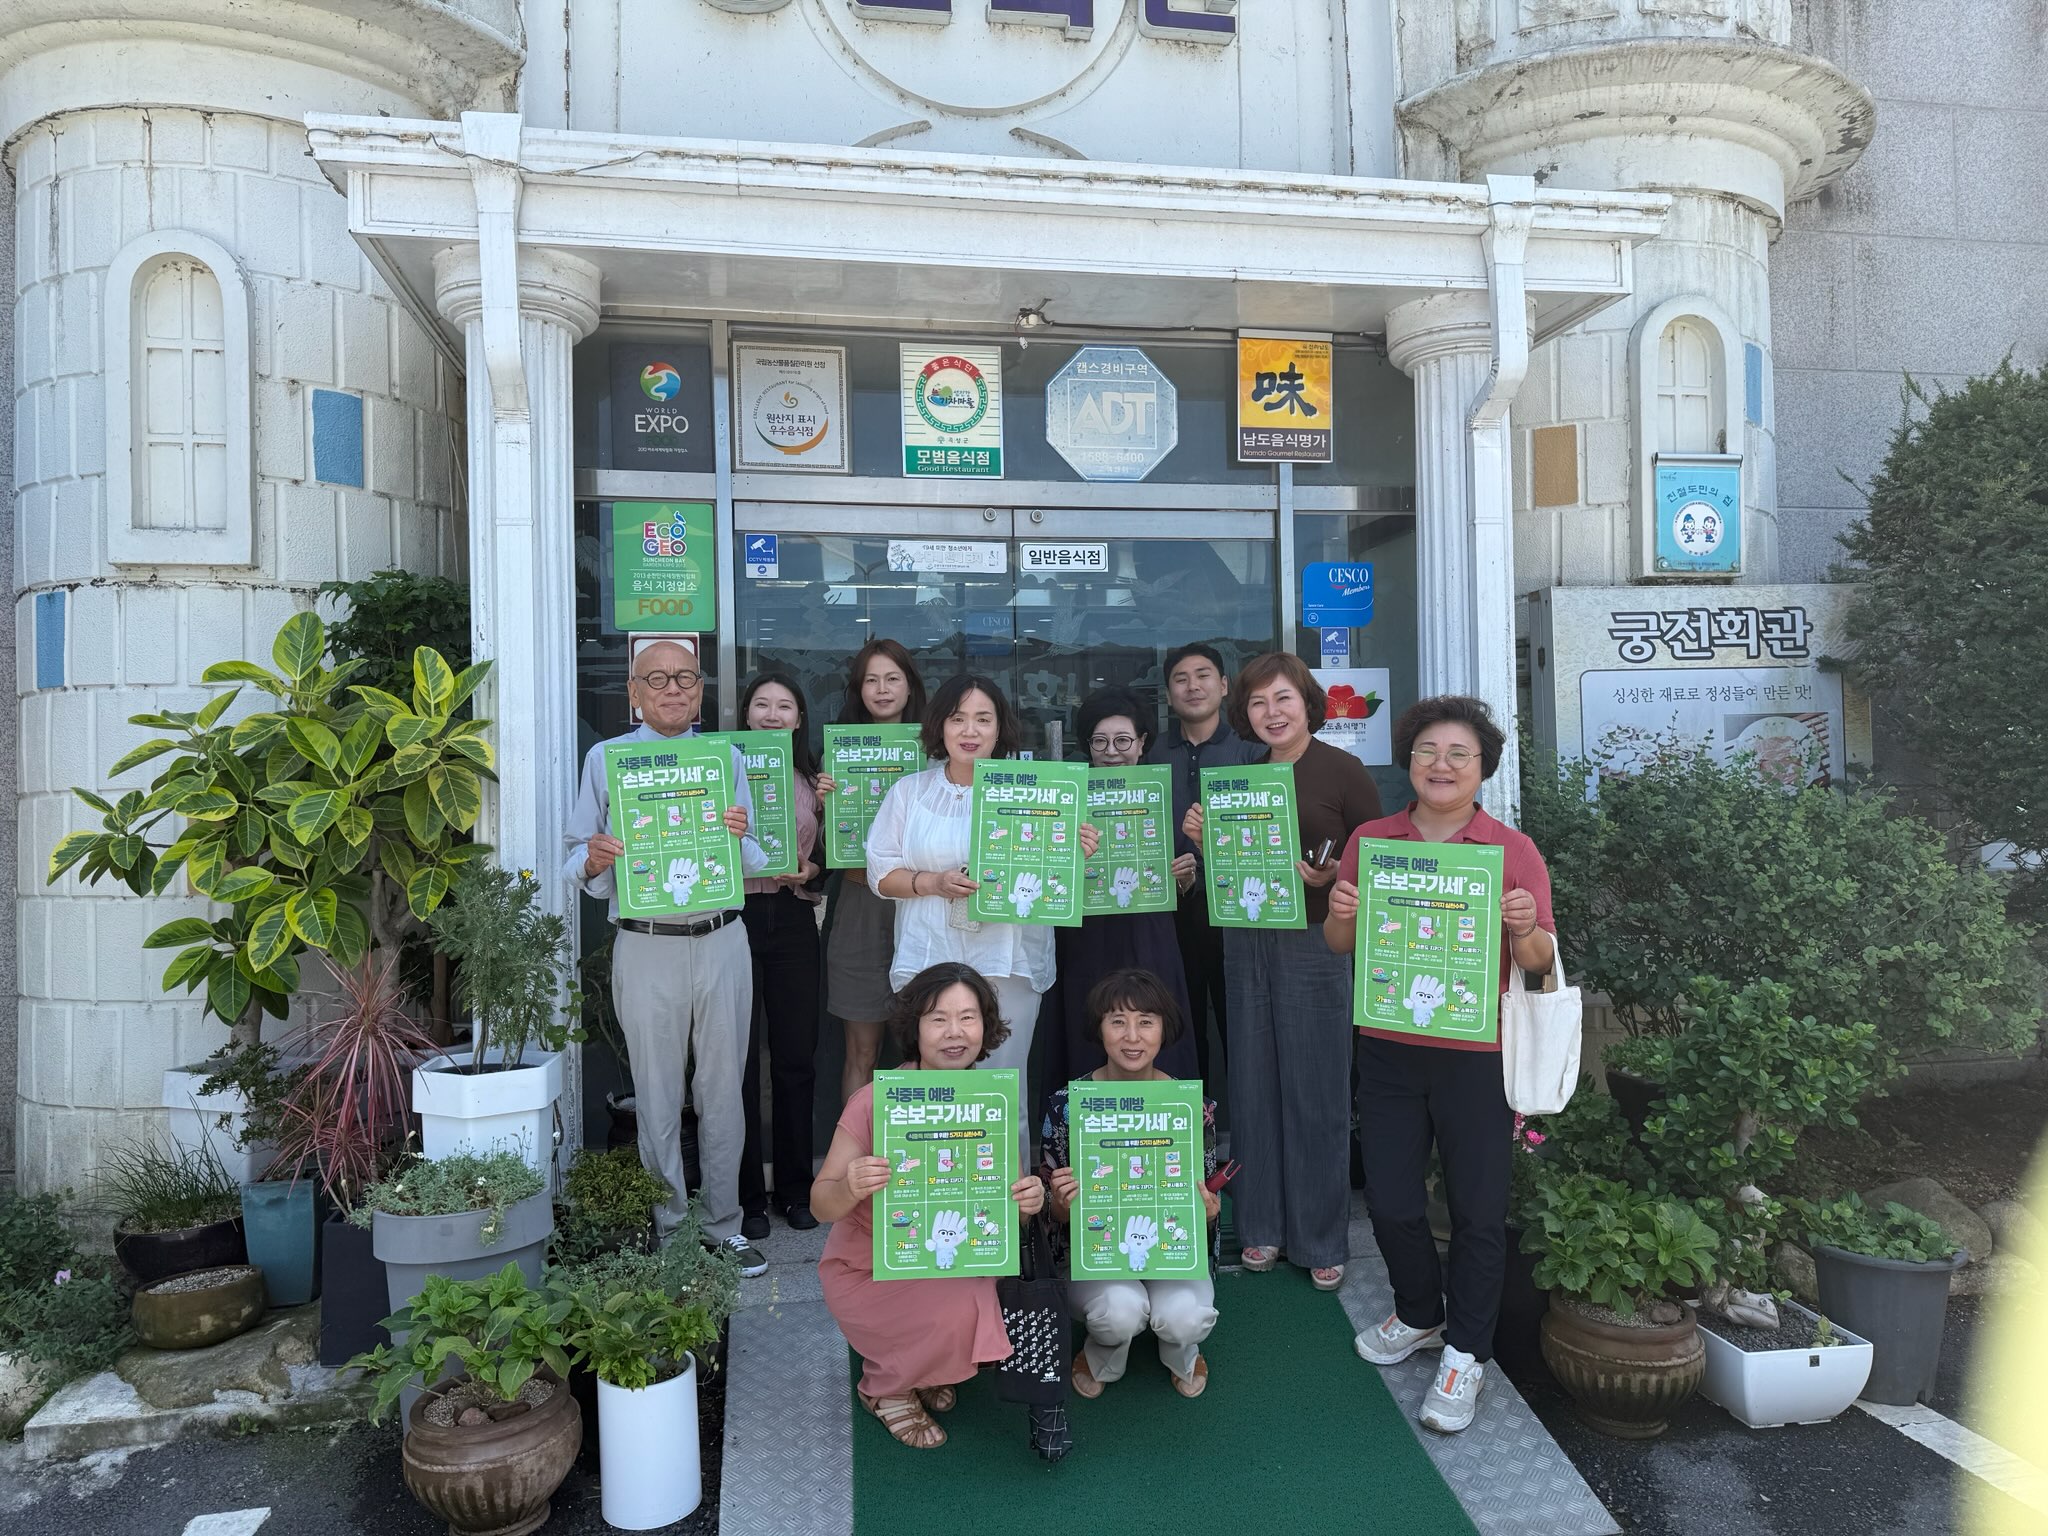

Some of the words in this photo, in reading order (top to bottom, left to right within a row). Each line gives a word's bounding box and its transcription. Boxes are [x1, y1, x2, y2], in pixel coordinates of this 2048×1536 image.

[813, 361, 826, 369] 선정
[1076, 362, 1148, 376] 캡스경비구역
[1252, 362, 1319, 418] 味
[940, 396, 975, 409] 기차마을
[766, 413, 794, 424] 원산지
[797, 414, 816, 425] 표시
[1070, 391, 1156, 435] ADT
[634, 414, 689, 433] EXPO
[769, 425, 814, 437] 우수음식점
[1243, 432, 1327, 448] 남도음식명가
[917, 450, 990, 466] 모범음식점
[1294, 450, 1326, 458] Restaurant
[917, 465, 940, 473] Good
[942, 465, 990, 473] Restaurant
[1667, 485, 1719, 504] 친절도민의
[643, 521, 686, 540] ECO
[643, 538, 687, 556] GEO
[1028, 549, 1101, 566] 일반음식점
[1328, 567, 1369, 583] CESCO
[631, 580, 653, 591] 음식
[656, 580, 698, 592] 지정업소
[1341, 584, 1370, 597] Members
[638, 598, 694, 616] FOOD
[1607, 606, 1814, 664] 궁전회관
[1612, 686, 1655, 704] 싱싱한
[1659, 686, 1701, 702] 재료로
[1705, 684, 1758, 703] 정성들여
[1763, 683, 1791, 701] 만든
[1794, 684, 1813, 701] 맛!
[833, 736, 861, 747] 식중독
[862, 735, 882, 746] 예방
[617, 756, 652, 770] 식중독
[654, 753, 678, 767] 예방
[983, 772, 1014, 785] 식중독
[1016, 773, 1038, 786] 예방
[1088, 778, 1105, 791] 중독
[1106, 778, 1126, 789] 예방
[1207, 779, 1231, 792] 식중독
[1231, 778, 1249, 791] 예방
[1370, 854, 1409, 871] 식중독
[1411, 857, 1439, 873] 예방
[886, 1087, 925, 1103] 식중독
[928, 1087, 956, 1102] 예방
[1080, 1097, 1117, 1112] 식중독
[1119, 1096, 1145, 1111] 예방
